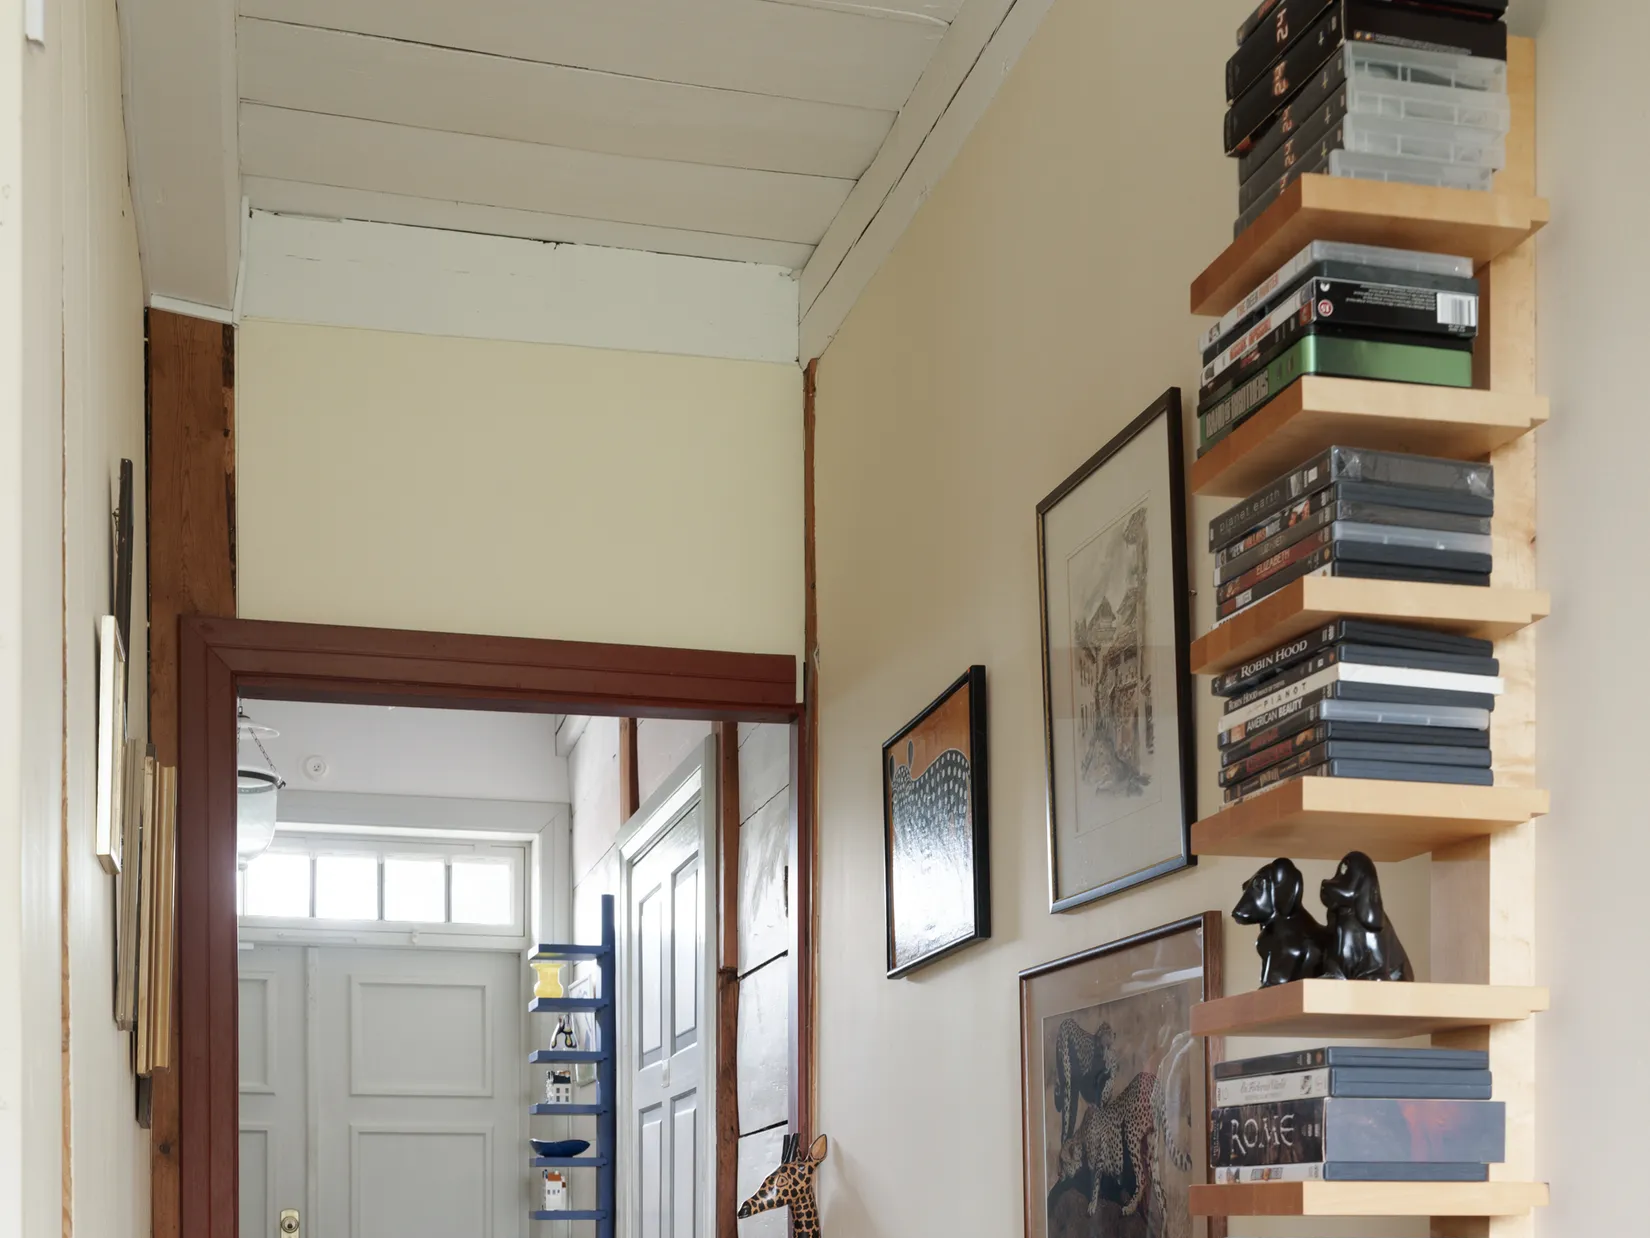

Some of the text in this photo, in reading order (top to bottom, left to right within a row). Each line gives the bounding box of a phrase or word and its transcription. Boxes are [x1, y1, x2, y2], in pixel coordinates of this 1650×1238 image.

[1220, 489, 1280, 534] planet earth
[1256, 549, 1290, 576] ELIZABETH
[1241, 640, 1308, 678] ROBIN HOOD
[1243, 690, 1258, 704] HOOD
[1263, 681, 1307, 708] PIANOT
[1246, 697, 1304, 732] AMERICAN BEAUTY
[1231, 1114, 1295, 1155] ROME
